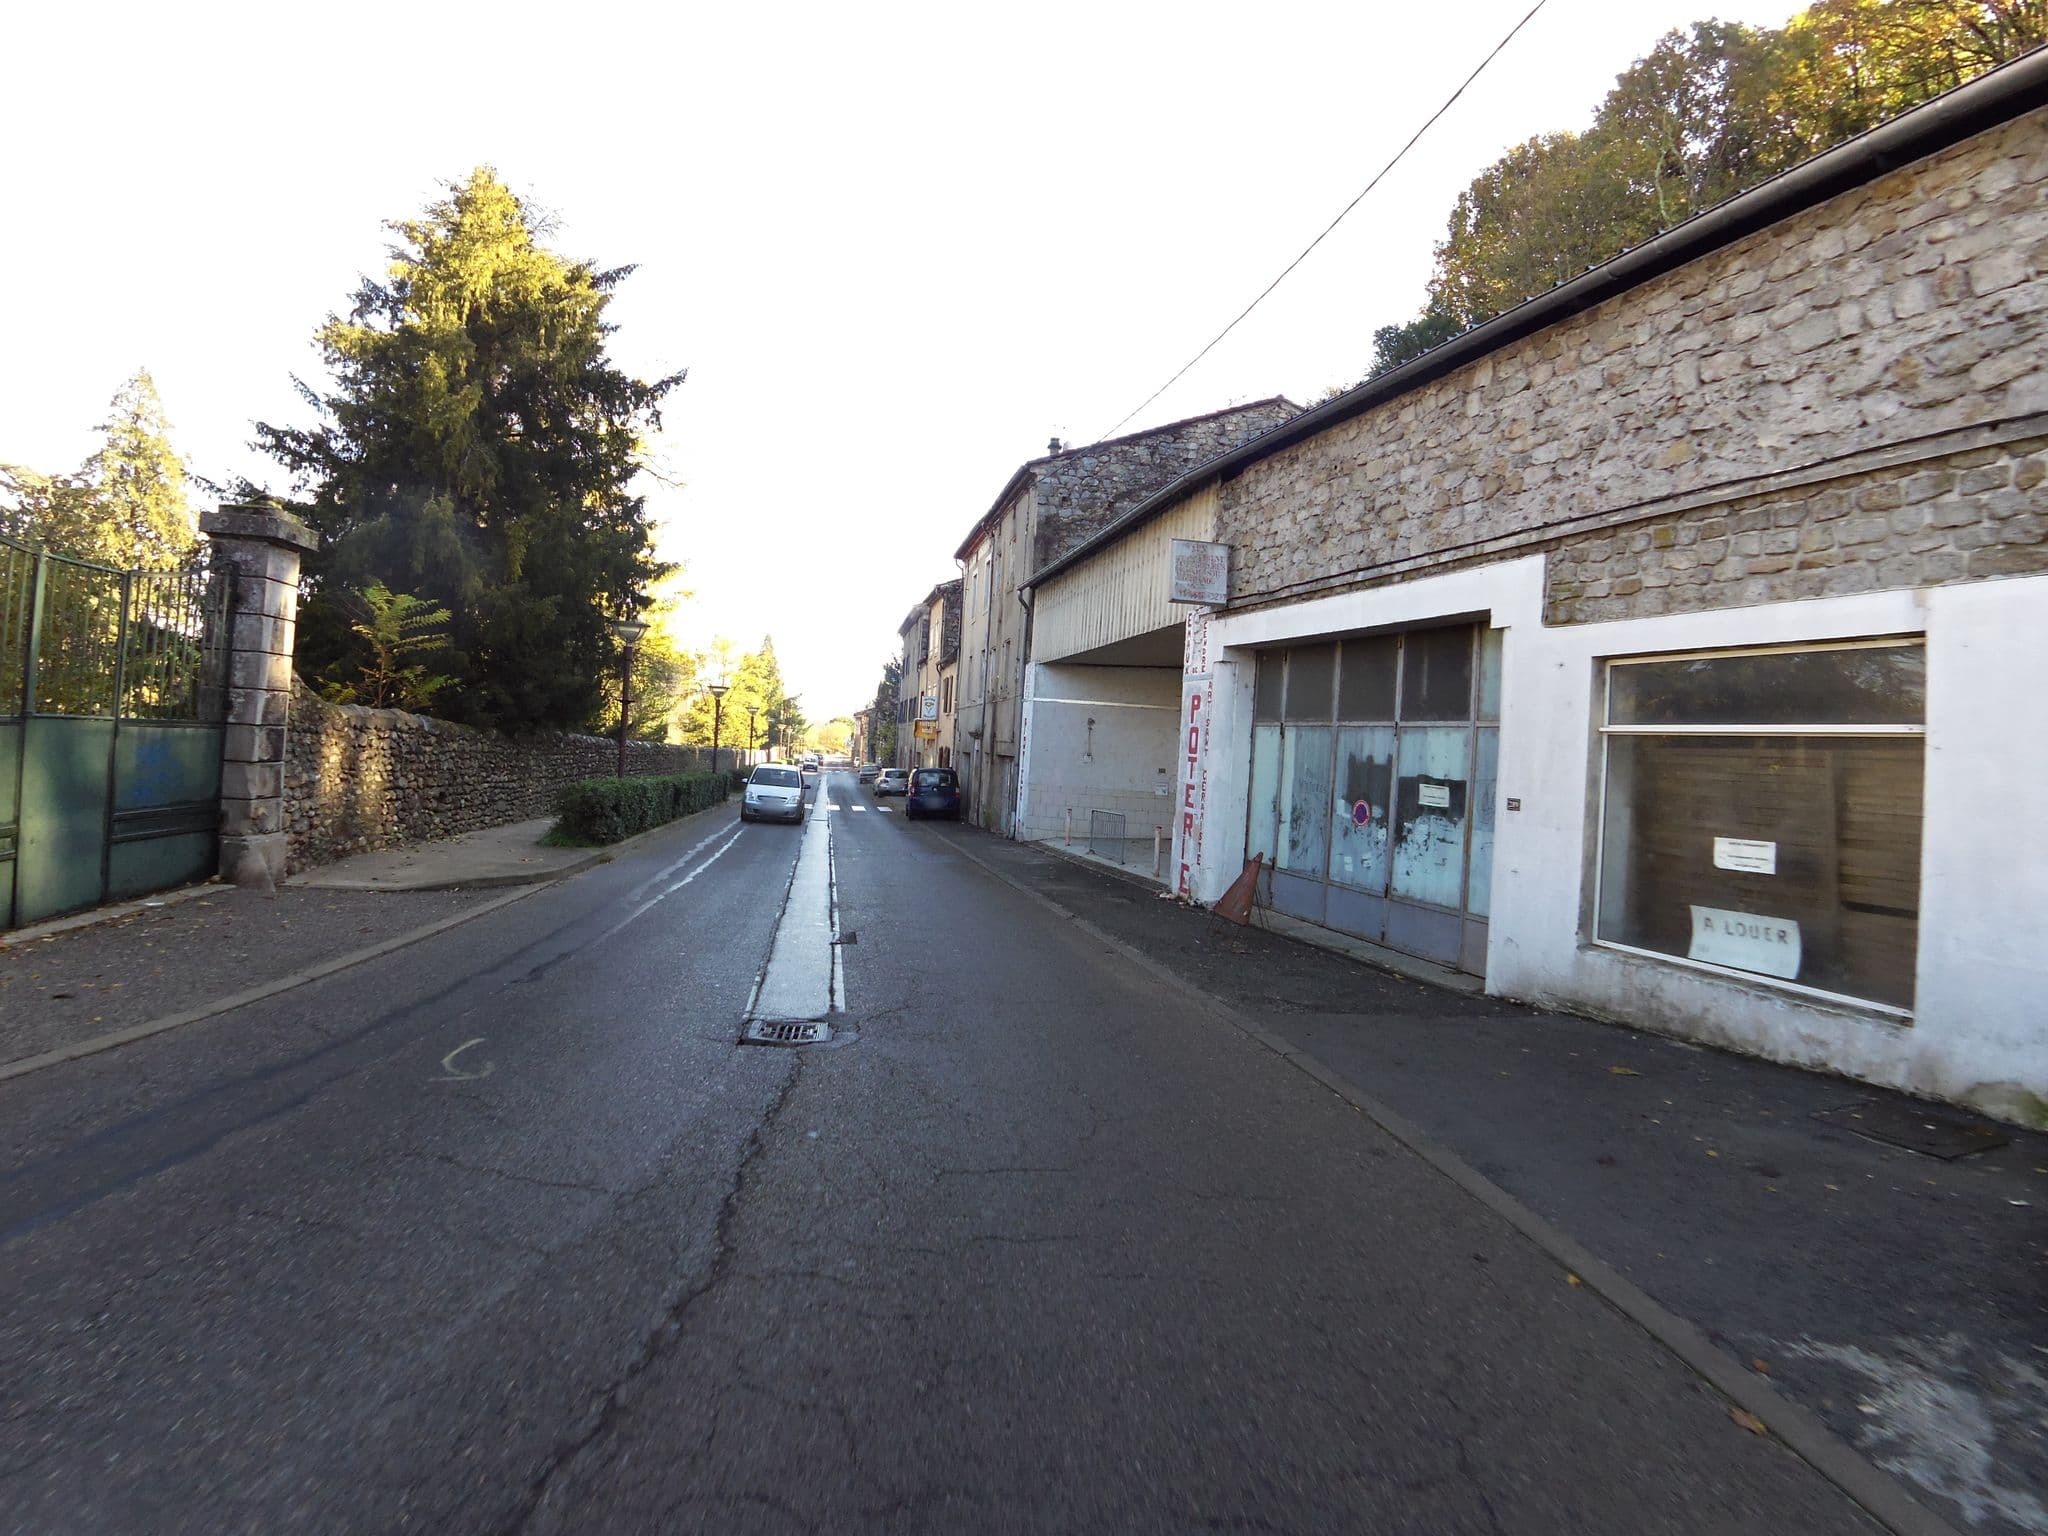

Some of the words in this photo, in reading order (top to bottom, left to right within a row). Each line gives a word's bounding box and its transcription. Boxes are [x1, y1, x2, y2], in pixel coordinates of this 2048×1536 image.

[1180, 694, 1201, 895] POTERIE
[1703, 916, 1714, 933] A
[1725, 921, 1788, 945] LOUER
